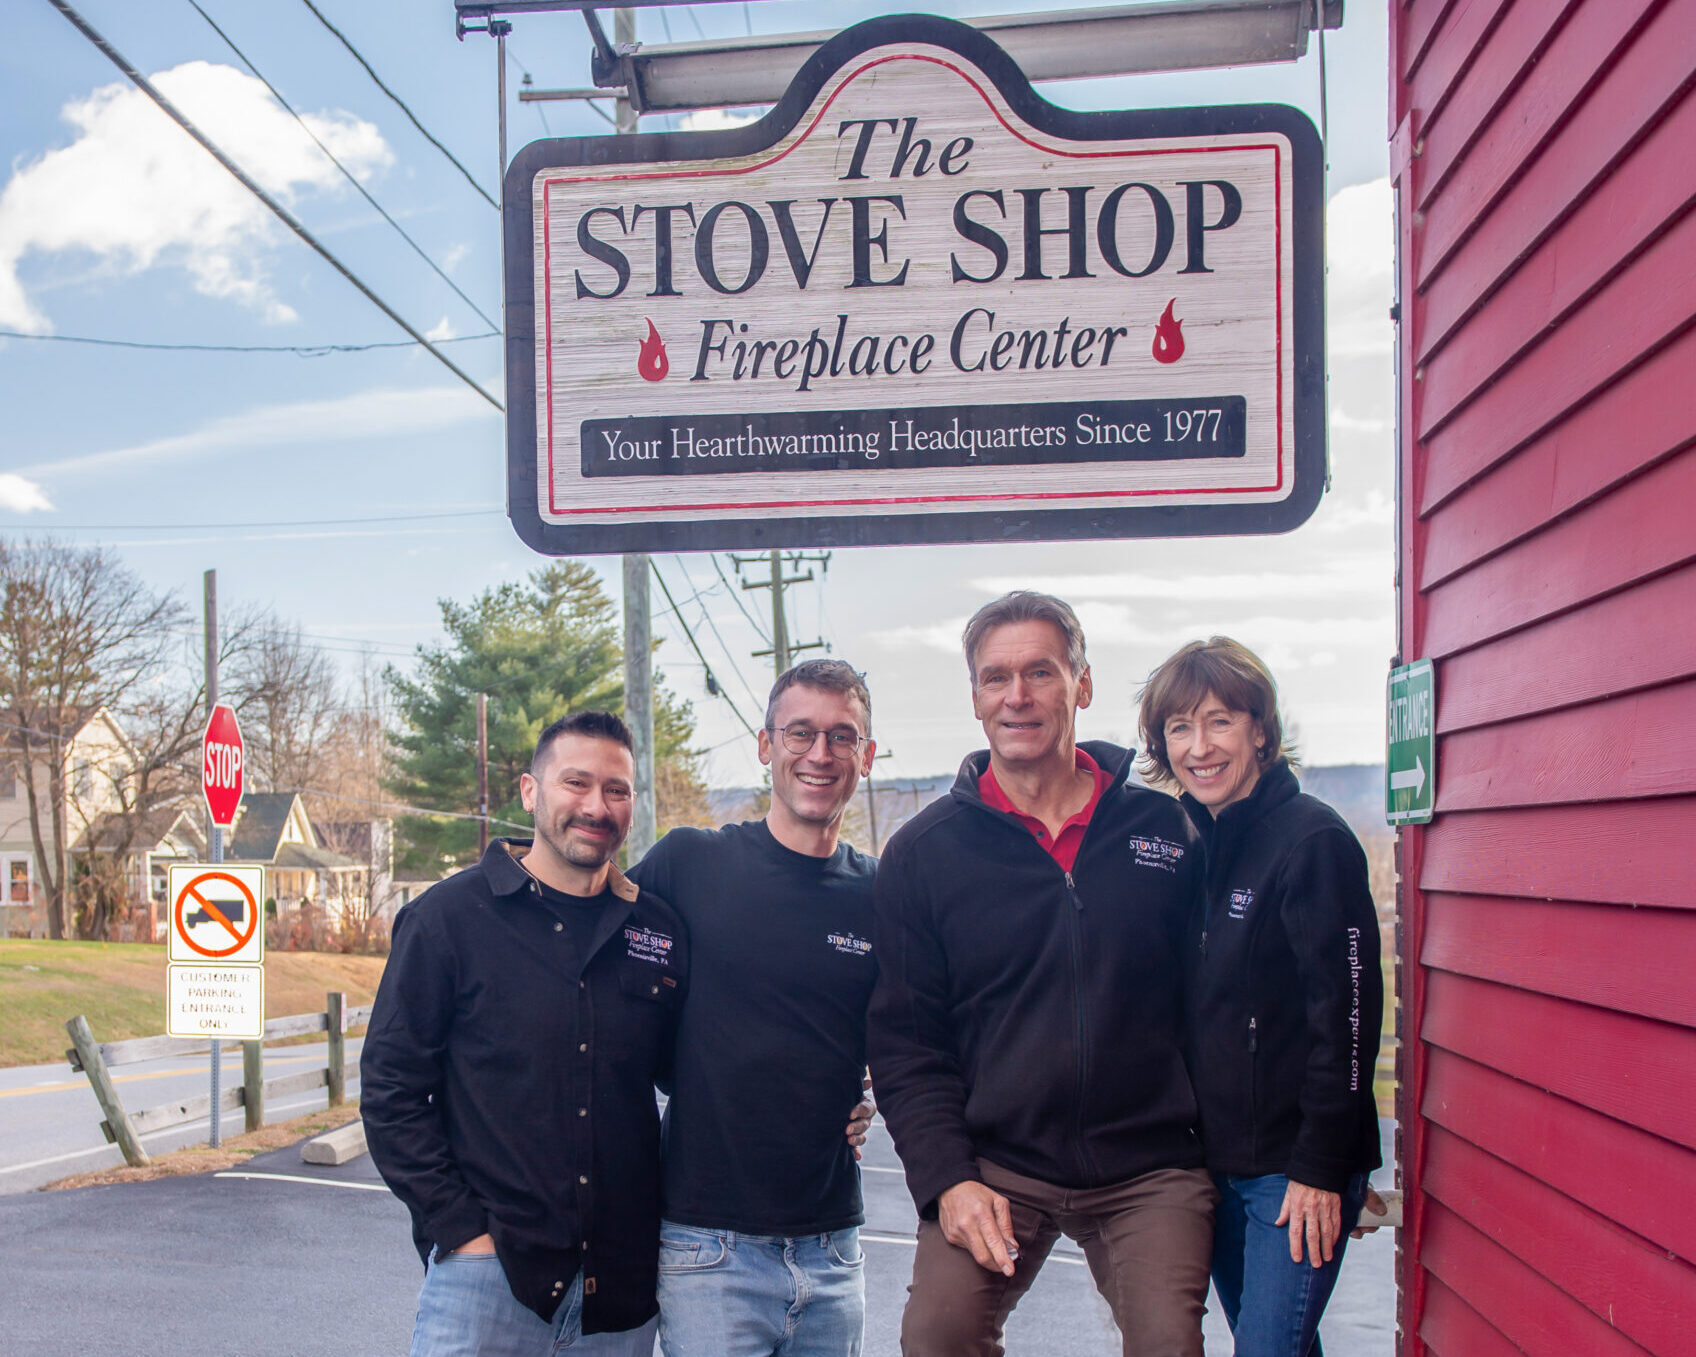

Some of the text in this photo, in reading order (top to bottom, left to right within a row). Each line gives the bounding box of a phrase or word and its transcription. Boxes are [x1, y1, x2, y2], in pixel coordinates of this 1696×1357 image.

[838, 116, 974, 181] The
[574, 180, 1242, 300] STOVE SHOP
[690, 308, 1128, 391] Fireplace Center
[601, 409, 1222, 461] Your Hearthwarming Headquarters Since 1977
[1388, 690, 1429, 744] ENTRANCE
[205, 741, 241, 789] STOP
[1129, 840, 1184, 858] STOVE SHOP
[624, 929, 673, 950] STOVE SHOP
[827, 934, 873, 952] STOVE SHOP
[181, 972, 251, 983] CUSTOMER
[188, 987, 242, 998] PARKING
[182, 1003, 246, 1014] ENTRANCE
[200, 1019, 231, 1029] ONLY
